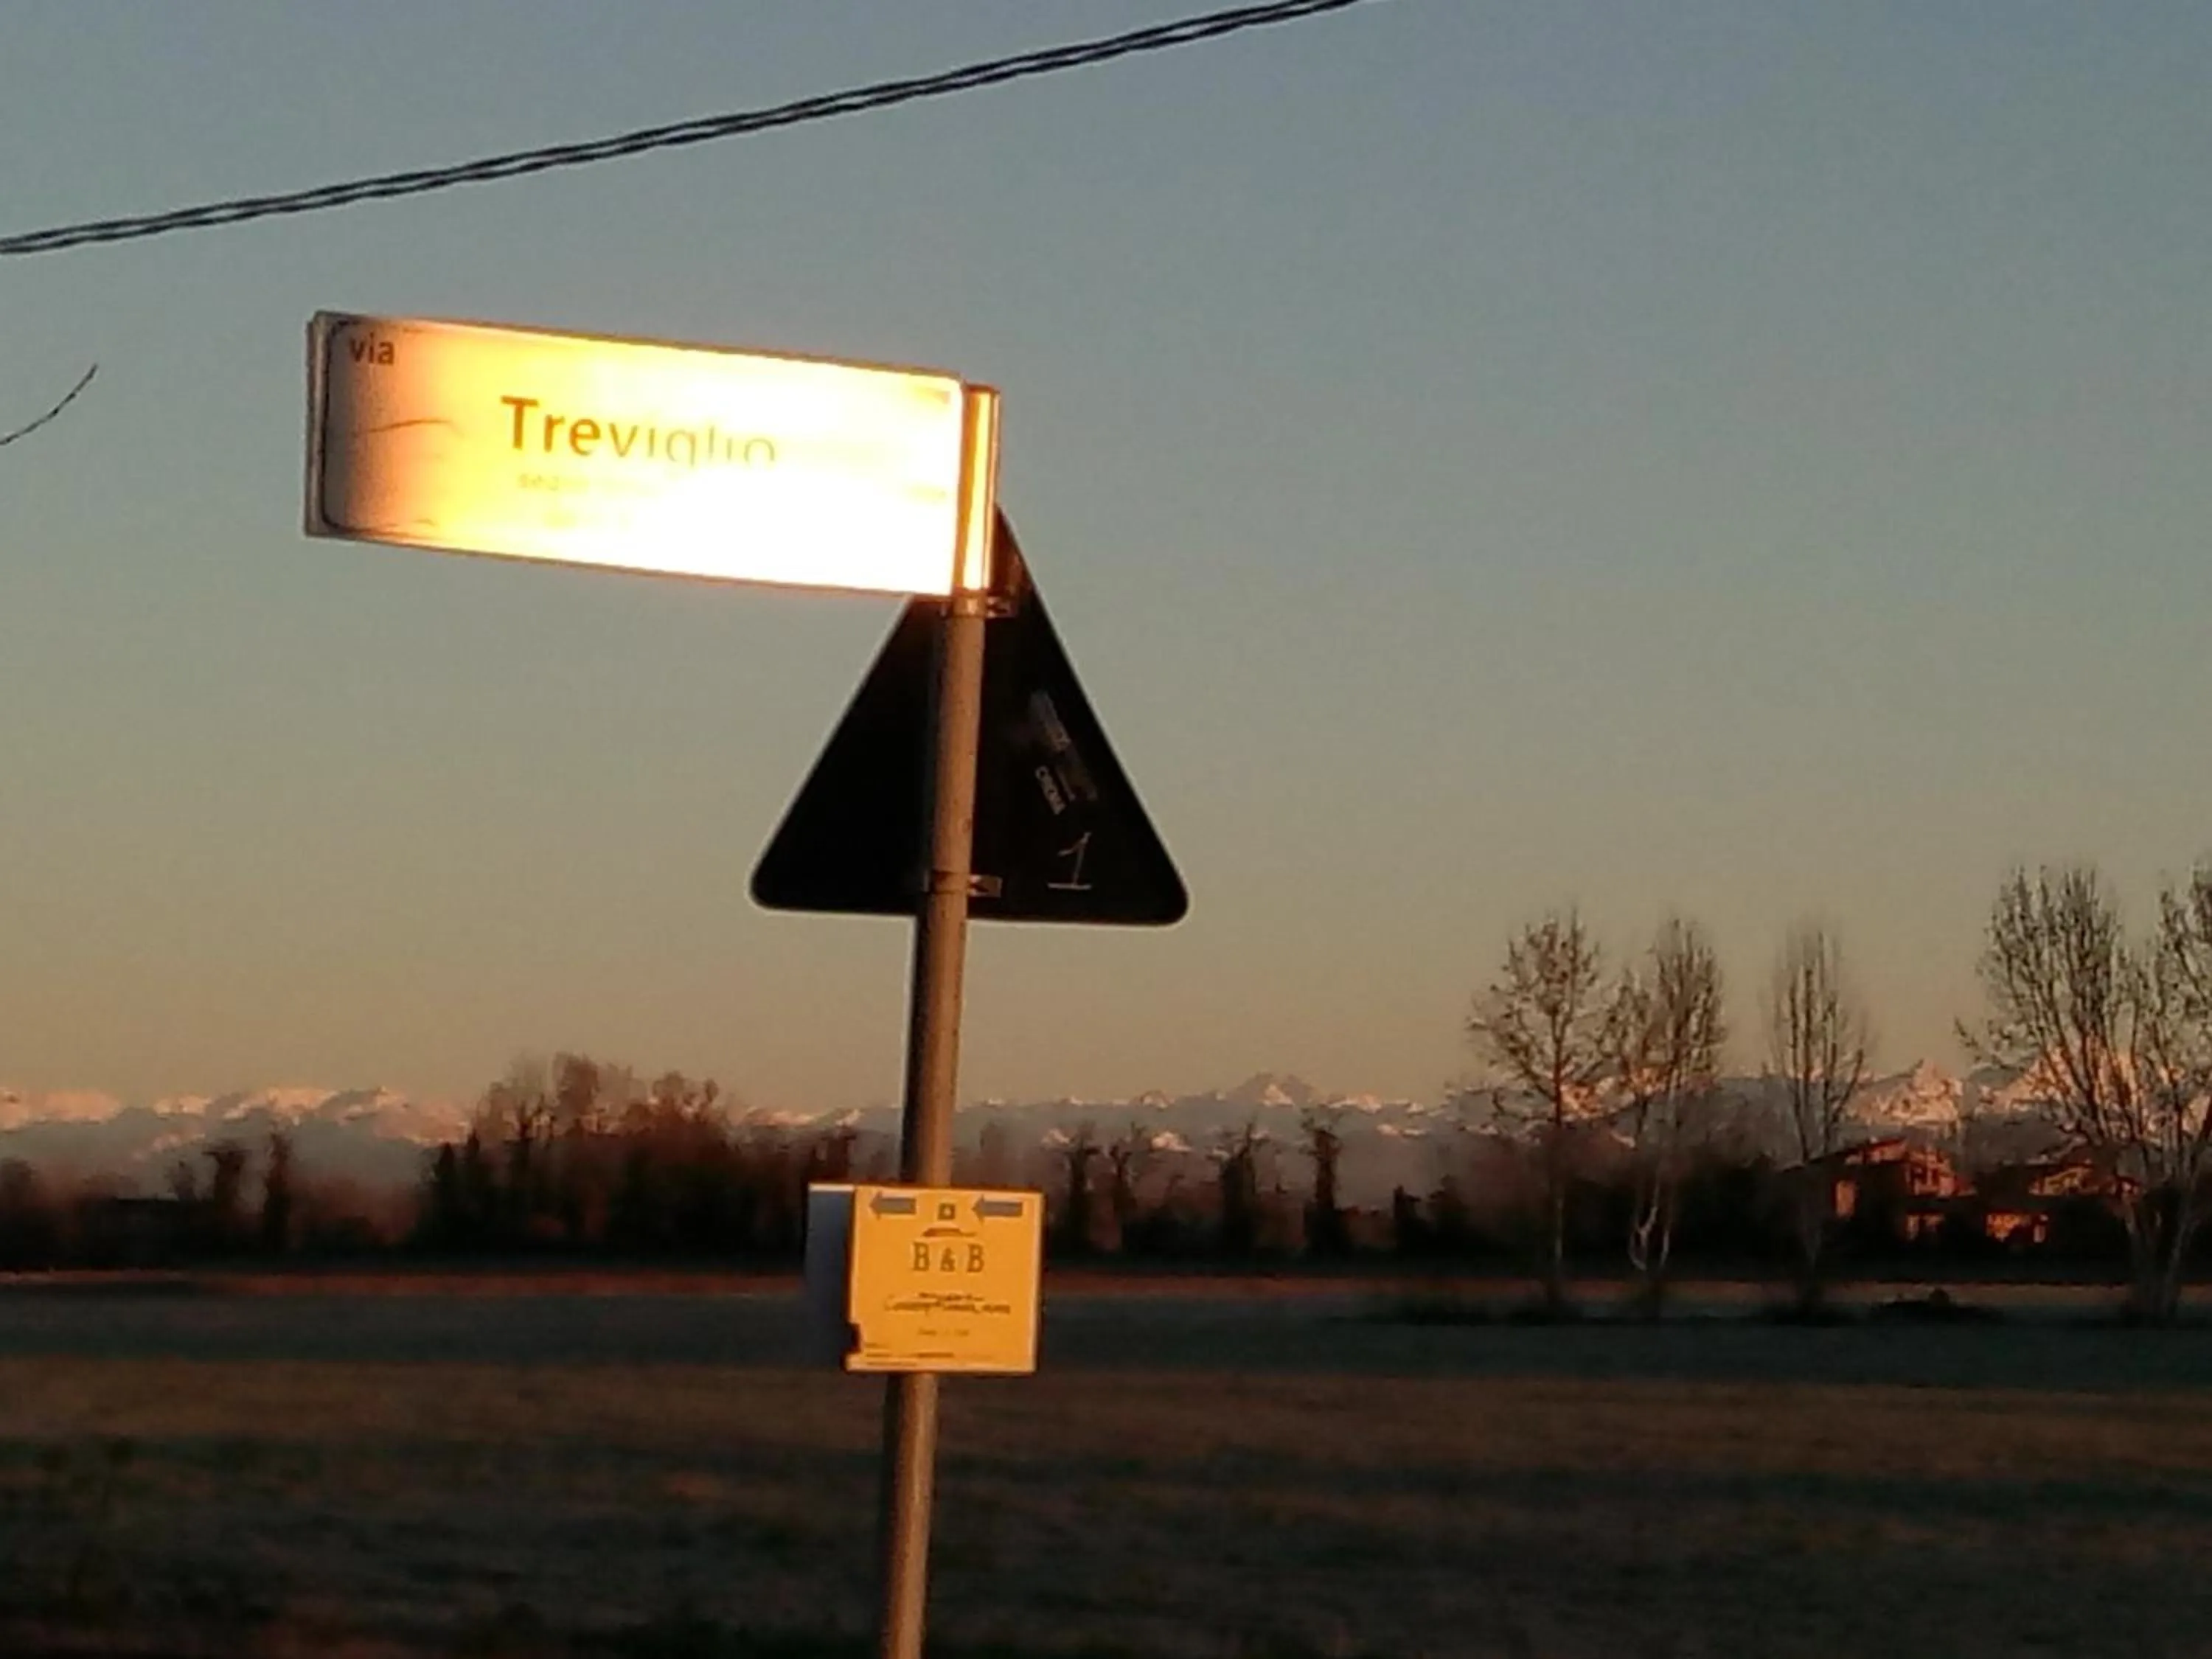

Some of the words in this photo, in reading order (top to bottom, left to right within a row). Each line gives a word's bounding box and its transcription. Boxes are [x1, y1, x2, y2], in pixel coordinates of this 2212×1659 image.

[349, 333, 395, 366] via
[500, 394, 776, 470] Treviglio
[913, 1241, 931, 1273] B
[939, 1247, 956, 1273] &
[967, 1242, 986, 1274] B
